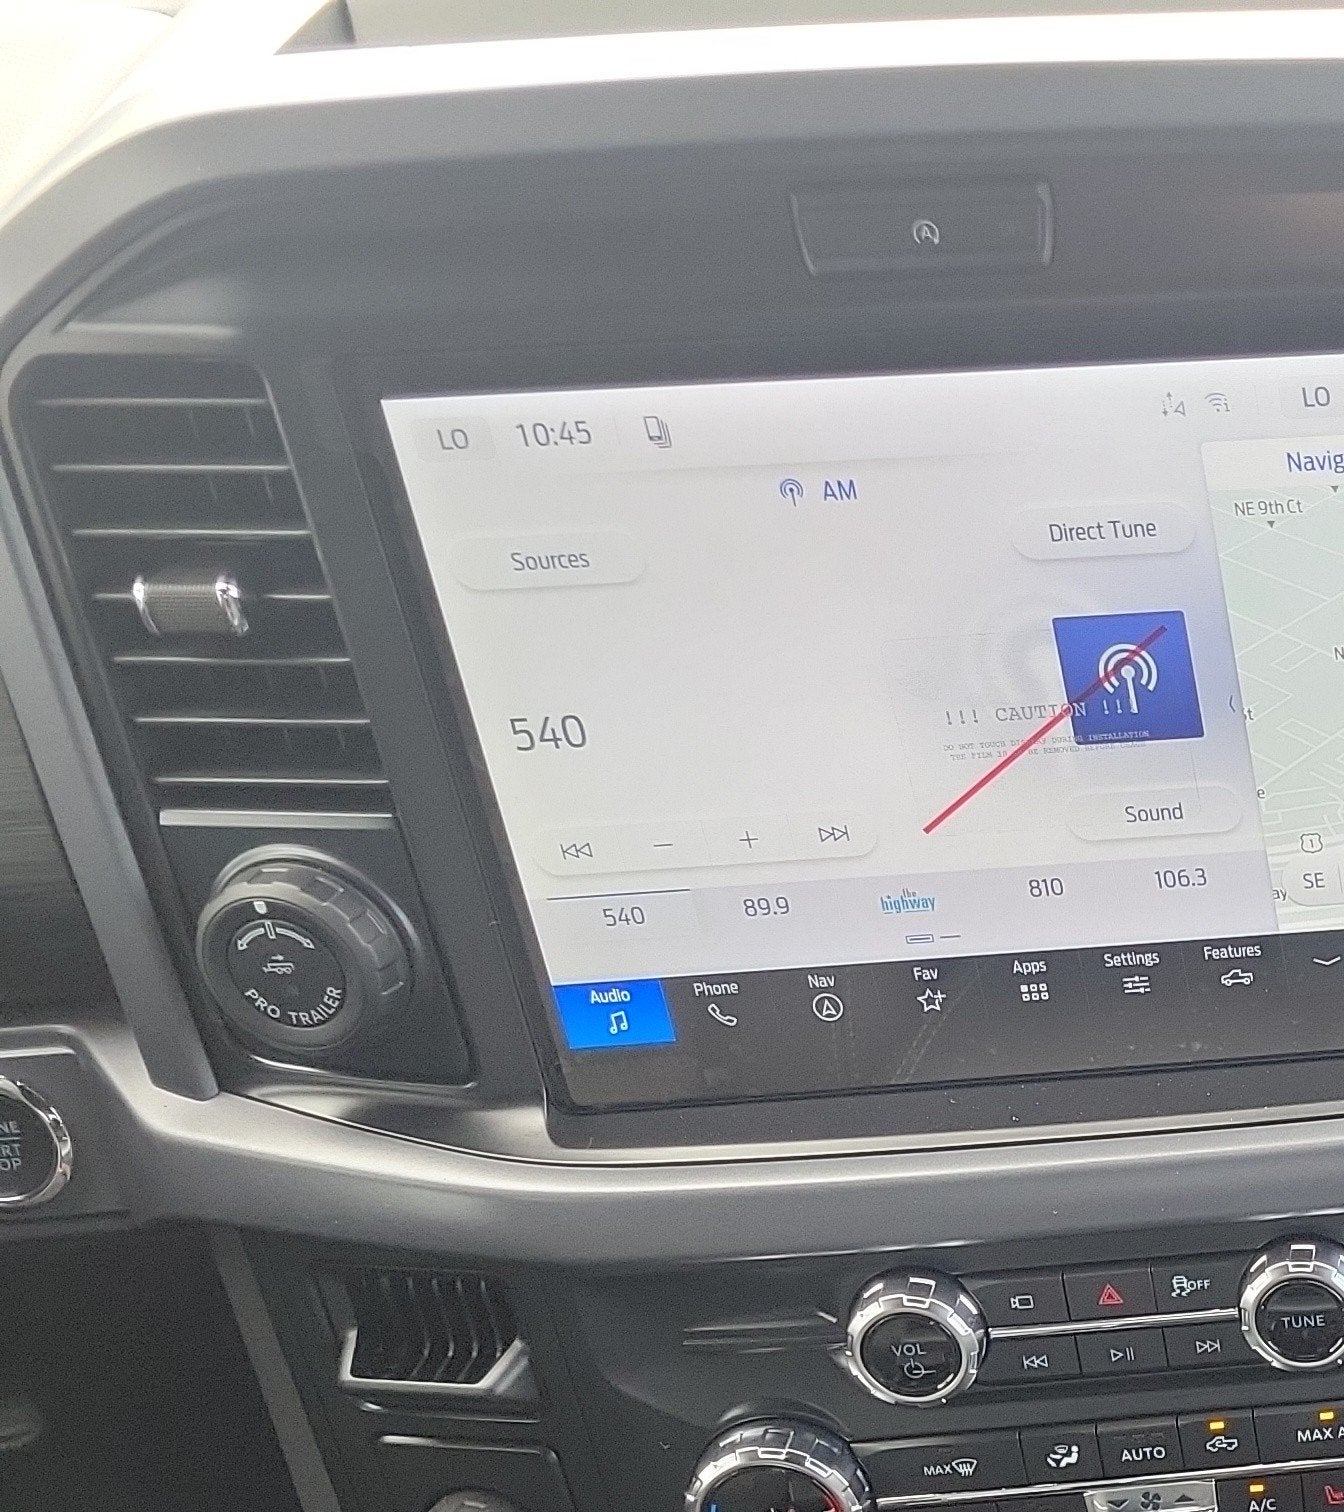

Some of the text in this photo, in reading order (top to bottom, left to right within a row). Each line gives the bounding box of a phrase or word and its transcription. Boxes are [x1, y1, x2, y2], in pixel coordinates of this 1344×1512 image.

[1302, 386, 1331, 408] LO
[437, 420, 592, 451] LO 10:45
[822, 479, 858, 501] AM
[1234, 499, 1304, 516] NE 9th Ct
[1048, 519, 1158, 543] Direct Tune
[510, 549, 590, 571] Sources
[995, 702, 1086, 722] CAUTION
[510, 714, 588, 751] 540
[980, 740, 1006, 749] TOUCH
[1088, 730, 1149, 741] INSTALLATION
[1043, 746, 1080, 754] REMOVED
[1124, 802, 1184, 824] Sound
[1028, 878, 1064, 898] 810
[1154, 868, 1208, 889] 106.3
[1302, 872, 1326, 889] SE
[744, 896, 790, 918] 89.9
[880, 894, 935, 914] highway
[602, 906, 646, 927] 540
[1103, 949, 1160, 969] Settings
[1203, 942, 1262, 961] Features
[913, 966, 939, 982] Fav
[1012, 959, 1047, 978] Apps
[693, 980, 739, 998] Phone
[807, 973, 836, 989] Nav
[590, 987, 631, 1004] Audio
[244, 986, 344, 1026] PRO TRAILER
[1186, 1278, 1211, 1292] OFF
[1280, 1314, 1326, 1330] TUNE
[891, 1344, 928, 1357] VOL
[1297, 1426, 1333, 1444] MAX
[1120, 1446, 1166, 1462] AUTO
[923, 1463, 953, 1477] MAX
[1248, 1497, 1278, 1512] A/C
